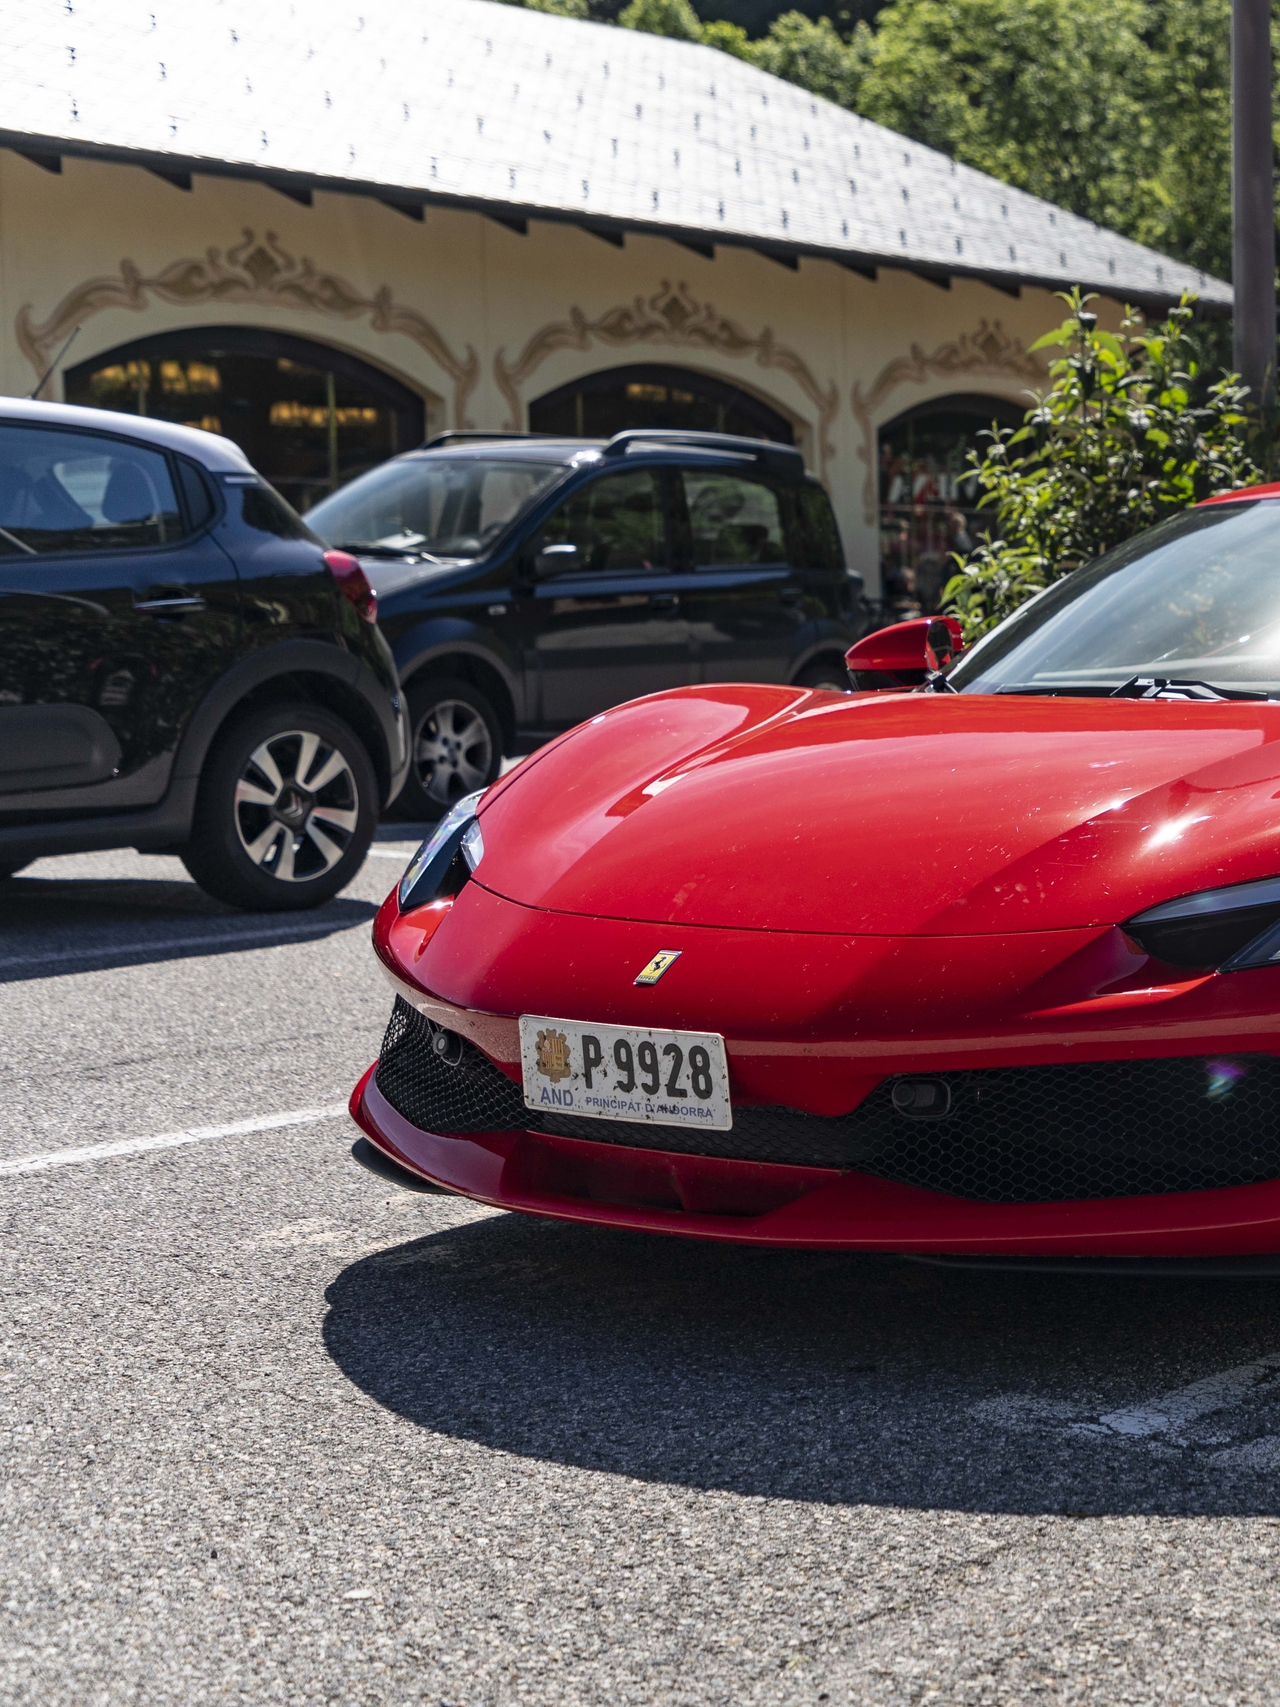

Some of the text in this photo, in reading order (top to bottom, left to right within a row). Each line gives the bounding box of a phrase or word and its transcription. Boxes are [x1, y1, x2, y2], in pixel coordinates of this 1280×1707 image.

[582, 1035, 713, 1100] P 9928
[540, 1087, 574, 1107] AND
[586, 1096, 713, 1118] PRINCIPAT D'ANDORRA
